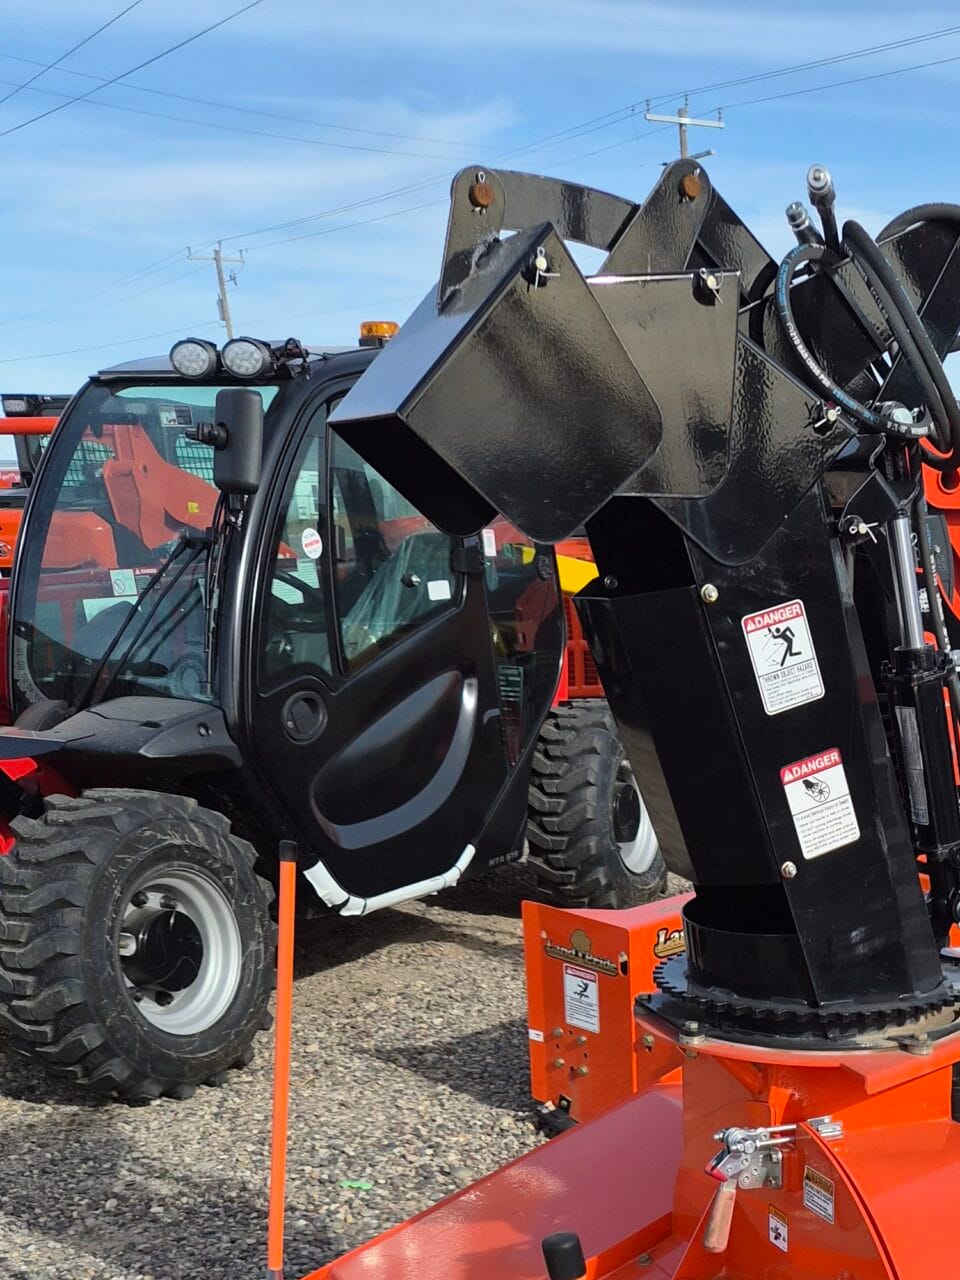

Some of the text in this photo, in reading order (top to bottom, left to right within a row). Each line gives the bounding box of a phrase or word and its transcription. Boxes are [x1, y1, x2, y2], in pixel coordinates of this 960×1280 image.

[754, 603, 801, 626] DANGER
[792, 752, 839, 777] DANGER
[656, 928, 685, 949] La
